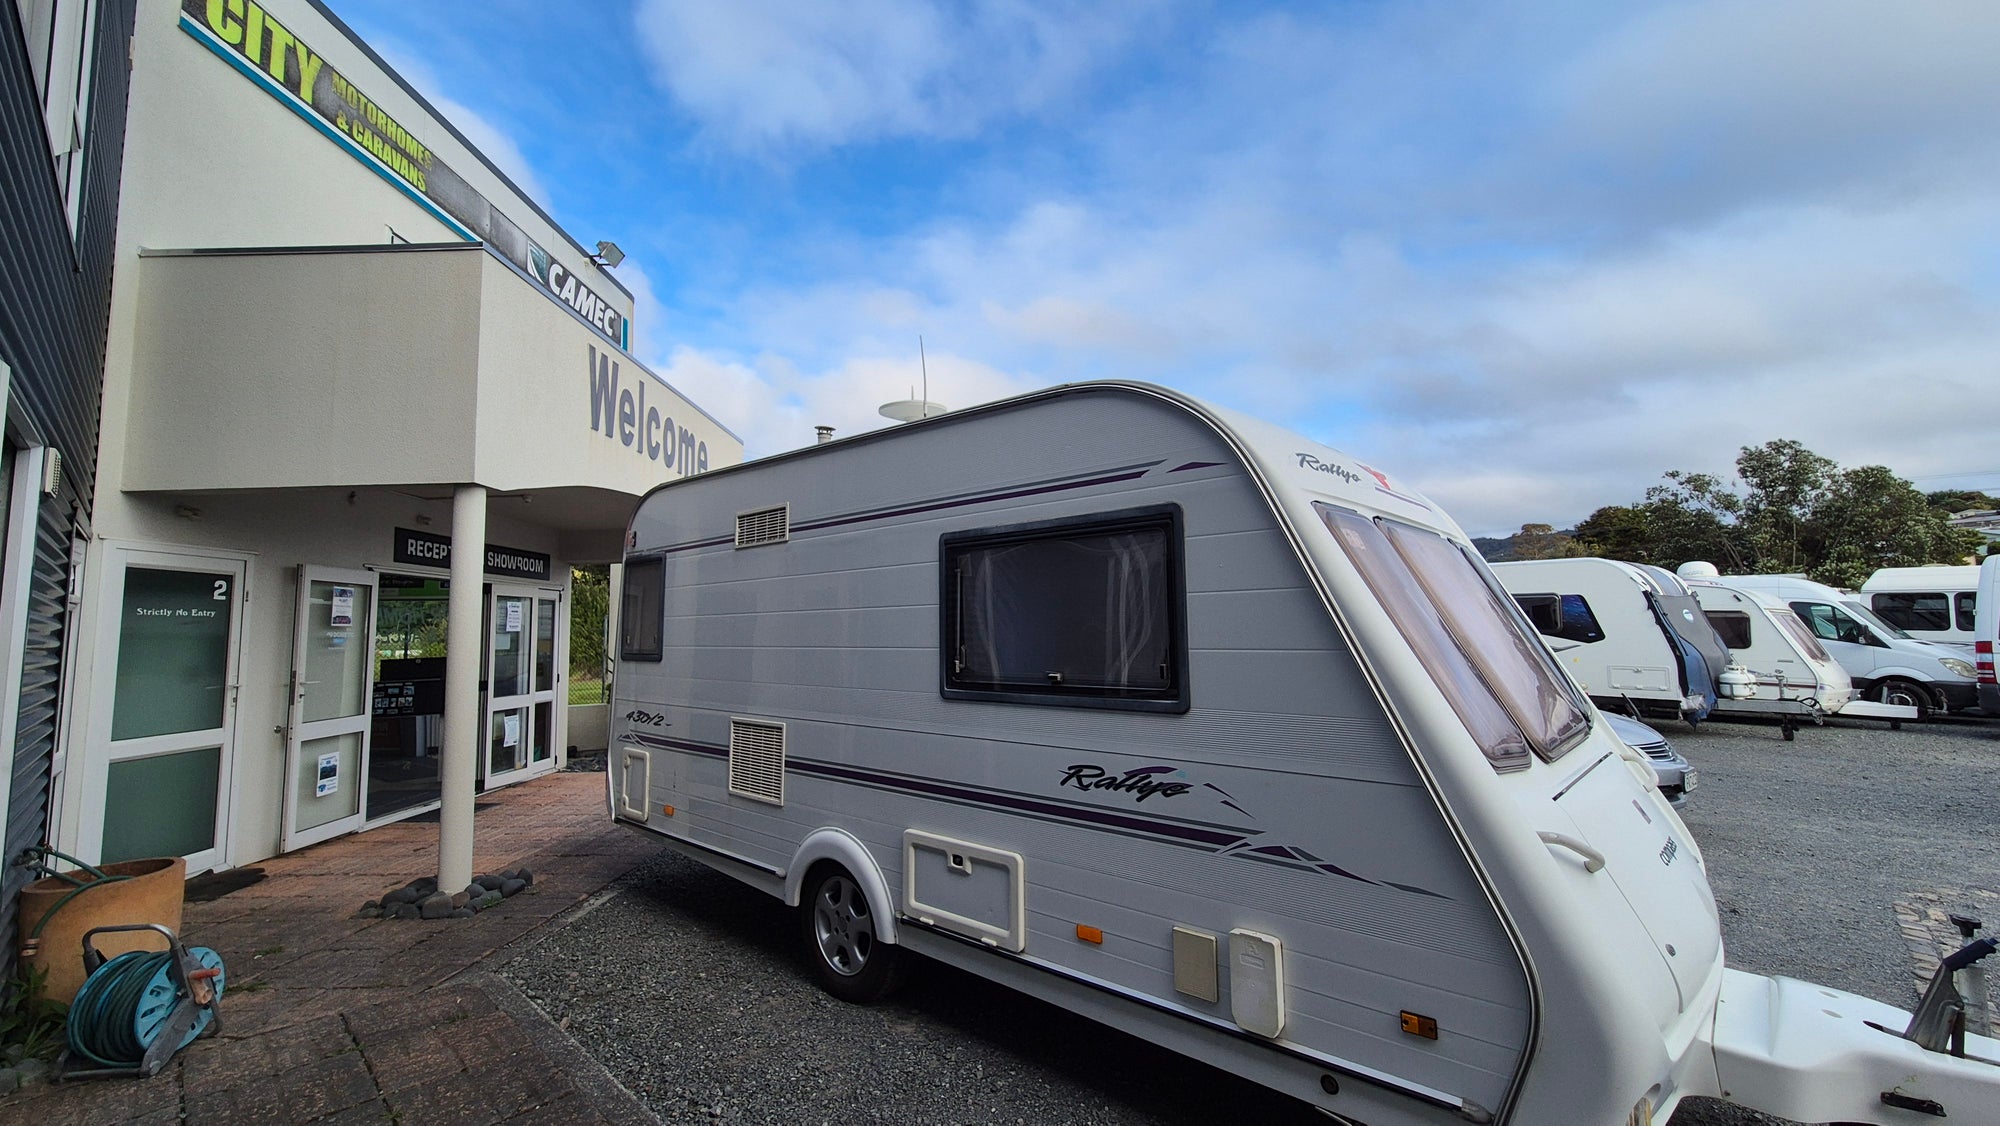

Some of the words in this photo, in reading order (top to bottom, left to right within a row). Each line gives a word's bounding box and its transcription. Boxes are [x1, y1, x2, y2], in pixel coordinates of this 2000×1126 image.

[206, 0, 323, 105] CITY
[332, 72, 432, 170] MOTORHOMES
[336, 110, 350, 133] &
[352, 119, 427, 192] CARAVANS
[549, 263, 616, 336] CAMEC
[588, 343, 708, 478] Welcome
[1295, 453, 1361, 484] Rallye
[407, 538, 452, 560] RECEP
[487, 551, 544, 574] SHOWROOM
[136, 607, 172, 617] Strictly
[176, 608, 188, 617] No
[191, 608, 216, 617] Entry
[213, 580, 227, 600] 2
[1060, 764, 1190, 802] Rallye
